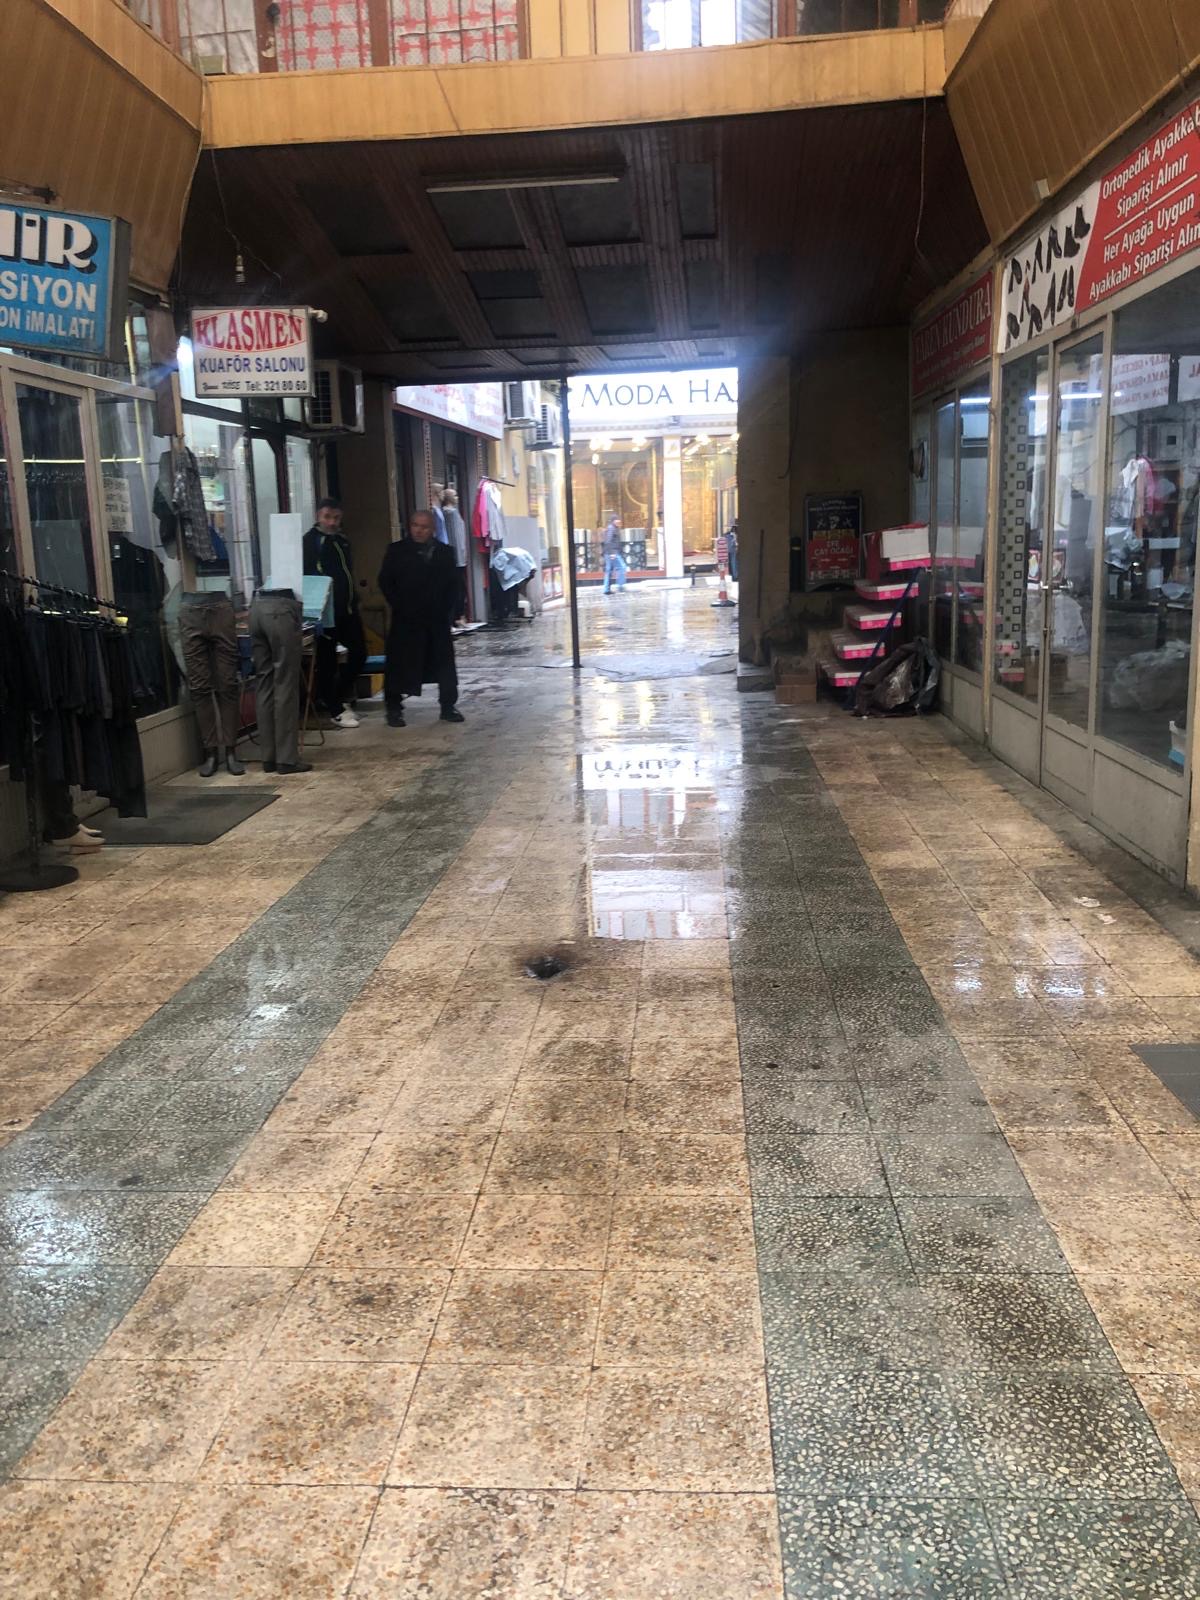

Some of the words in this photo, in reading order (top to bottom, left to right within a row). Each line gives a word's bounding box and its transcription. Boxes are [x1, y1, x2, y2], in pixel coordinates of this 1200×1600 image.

[1103, 147, 1150, 199] Ortopedik
[1117, 174, 1153, 218] Siparişi
[1156, 153, 1188, 190] Alınır
[1103, 243, 1119, 263] Her
[1121, 218, 1153, 253] Ayağa
[1157, 193, 1194, 231] Uygun
[1089, 262, 1131, 301] Ayakkabı
[1133, 233, 1174, 275] Siparişi
[195, 310, 302, 351] KLASMEN
[200, 354, 246, 373] KUAFÖR
[255, 357, 305, 372] SALONU
[245, 381, 261, 391] Tel:
[263, 380, 279, 391] 321
[581, 383, 673, 407] MODA
[689, 379, 737, 403] HA
